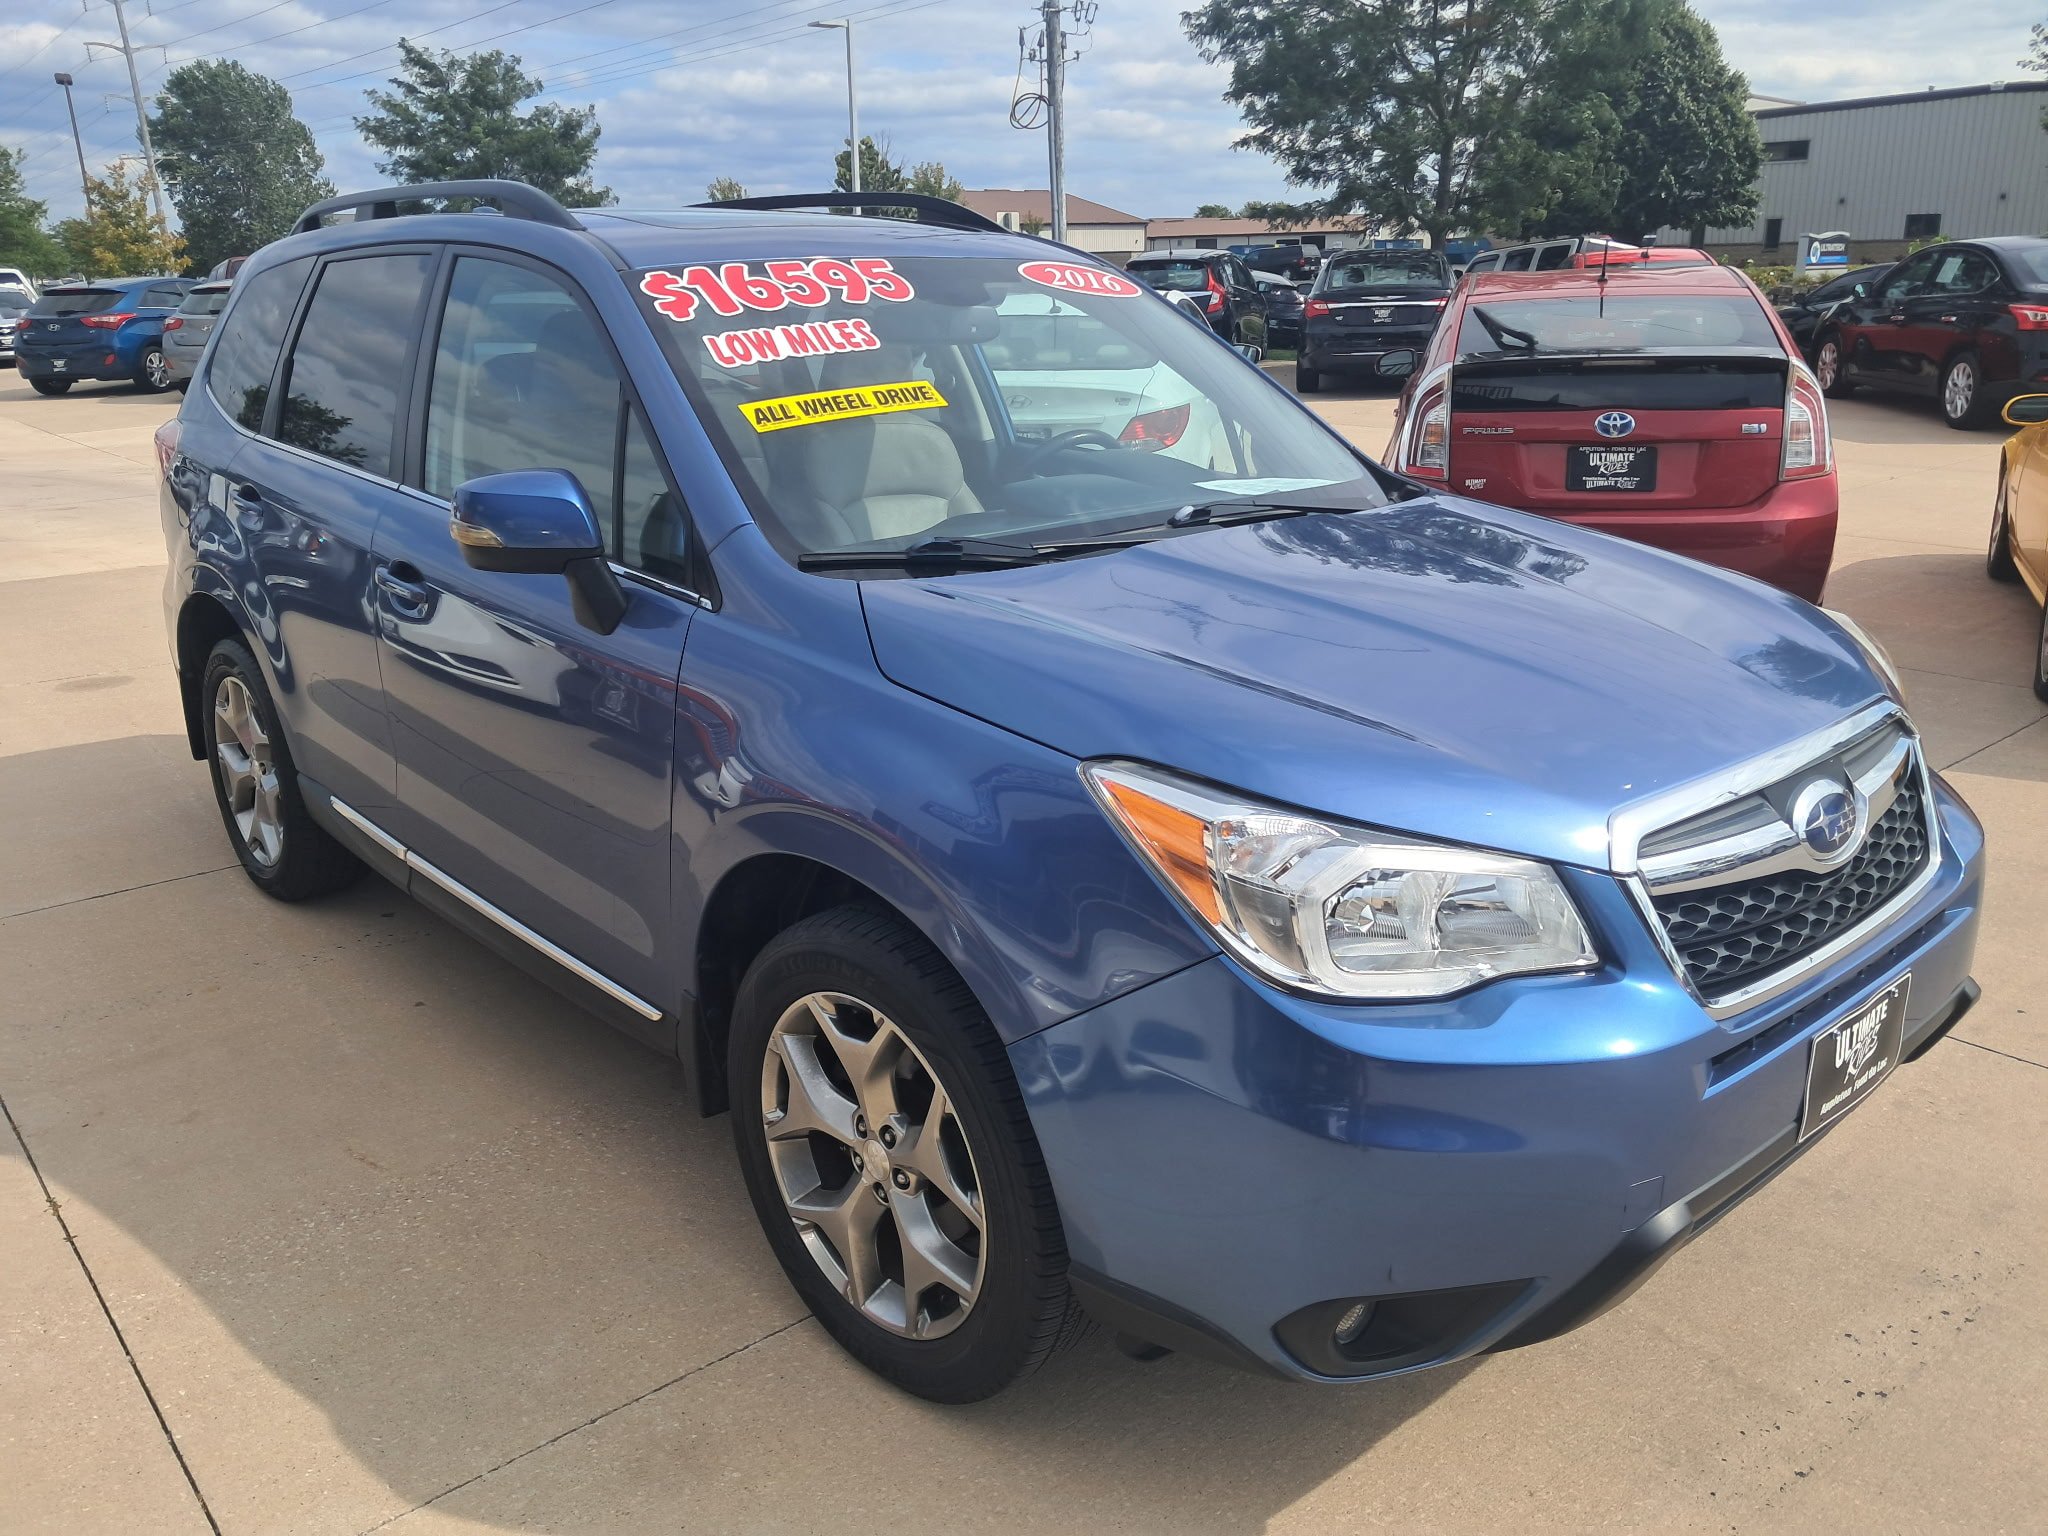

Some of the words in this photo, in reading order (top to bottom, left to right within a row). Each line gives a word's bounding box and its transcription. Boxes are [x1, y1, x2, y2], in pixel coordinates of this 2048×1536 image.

[642, 259, 914, 321] $16595
[1044, 267, 1122, 292] 2016
[706, 328, 782, 366] LOW
[783, 319, 877, 356] MILES
[754, 404, 797, 428] ALL
[795, 392, 874, 418] WHEEL
[874, 385, 936, 408] DRIVE
[1462, 427, 1515, 435] PRIUS
[1589, 453, 1635, 467] ULTIMATE
[1598, 461, 1630, 475] RIDES
[1586, 480, 1615, 489] ULTIMATE
[1835, 998, 1889, 1069] ULTIMATE
[1844, 1023, 1882, 1084] RIDES
[1853, 1070, 1869, 1092] Fond
